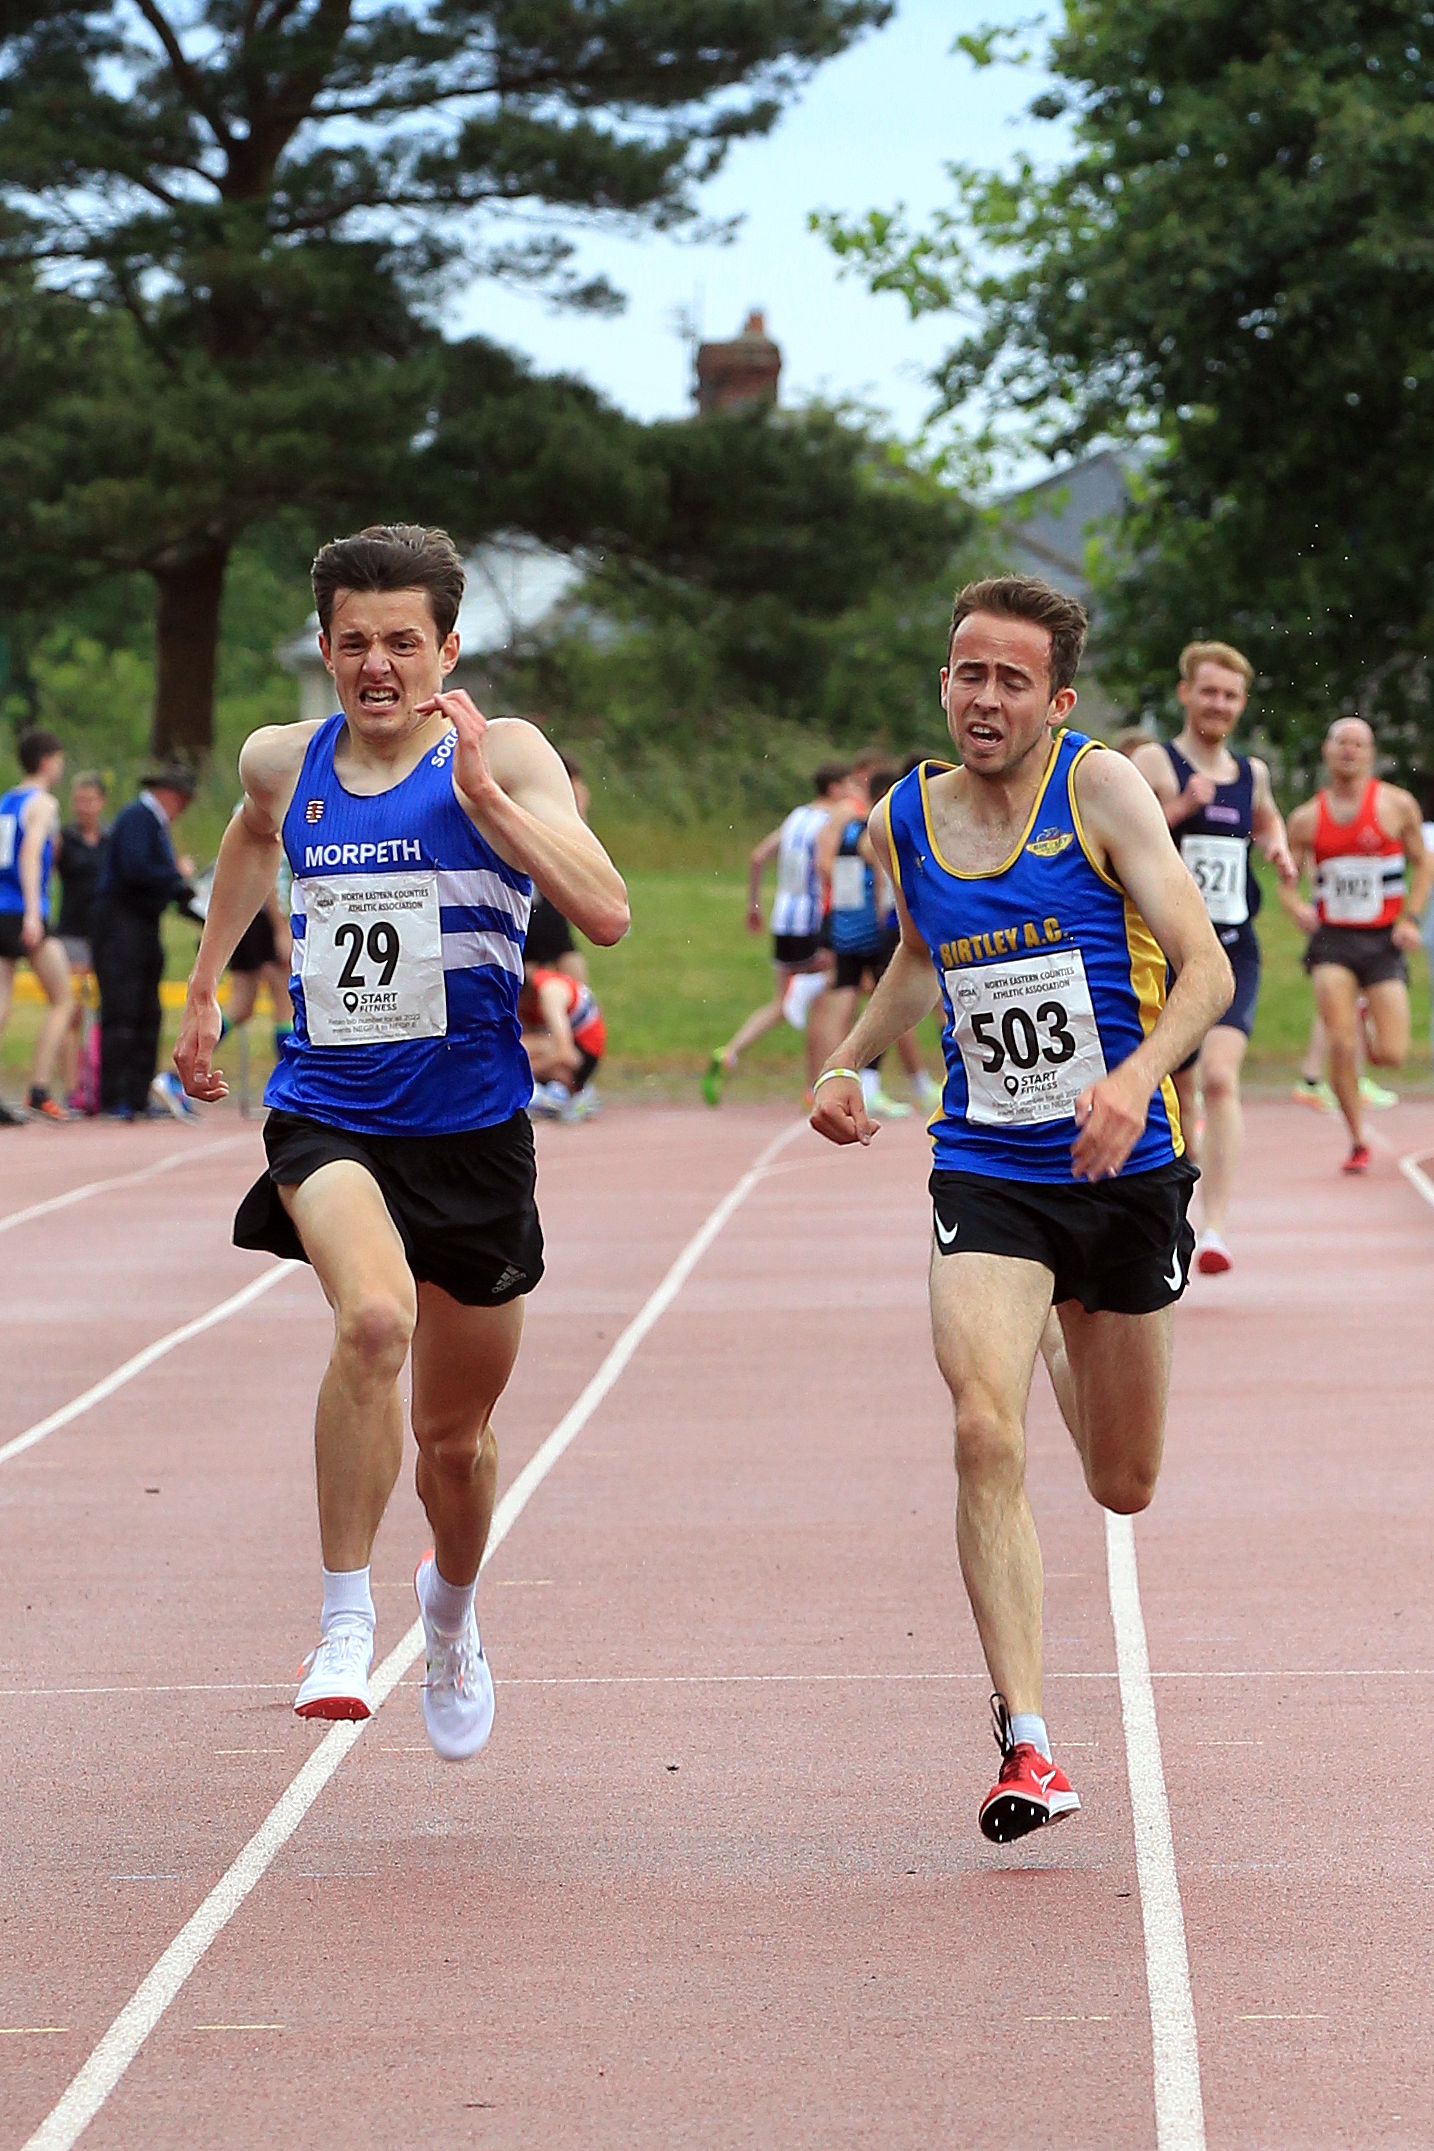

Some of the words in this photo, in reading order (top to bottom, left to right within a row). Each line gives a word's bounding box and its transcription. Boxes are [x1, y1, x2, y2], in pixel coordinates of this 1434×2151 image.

[305, 839, 421, 868] MORPETH
[1195, 857, 1237, 891] 521
[341, 892, 363, 901] NORTH
[365, 890, 393, 900] EASTERN
[394, 888, 429, 899] COUNTIES
[348, 903, 376, 912] ATHLETIC
[379, 901, 423, 911] ASSOCIATION
[939, 926, 1018, 968] BIRTLEY
[1023, 916, 1068, 948] A.C.
[334, 921, 400, 989] 29
[984, 979, 1009, 989] NORTH
[1009, 973, 1039, 986] EASTERN
[1040, 966, 1075, 980] COUNTIES
[360, 992, 398, 1004] START
[993, 987, 1024, 1000] ATHLETIC
[1025, 979, 1071, 994] ASSOCIATION
[360, 1003, 398, 1013] FITNESS
[971, 1001, 1076, 1073] 503
[1021, 1070, 1058, 1087] START
[1021, 1080, 1058, 1095] FITNESS
